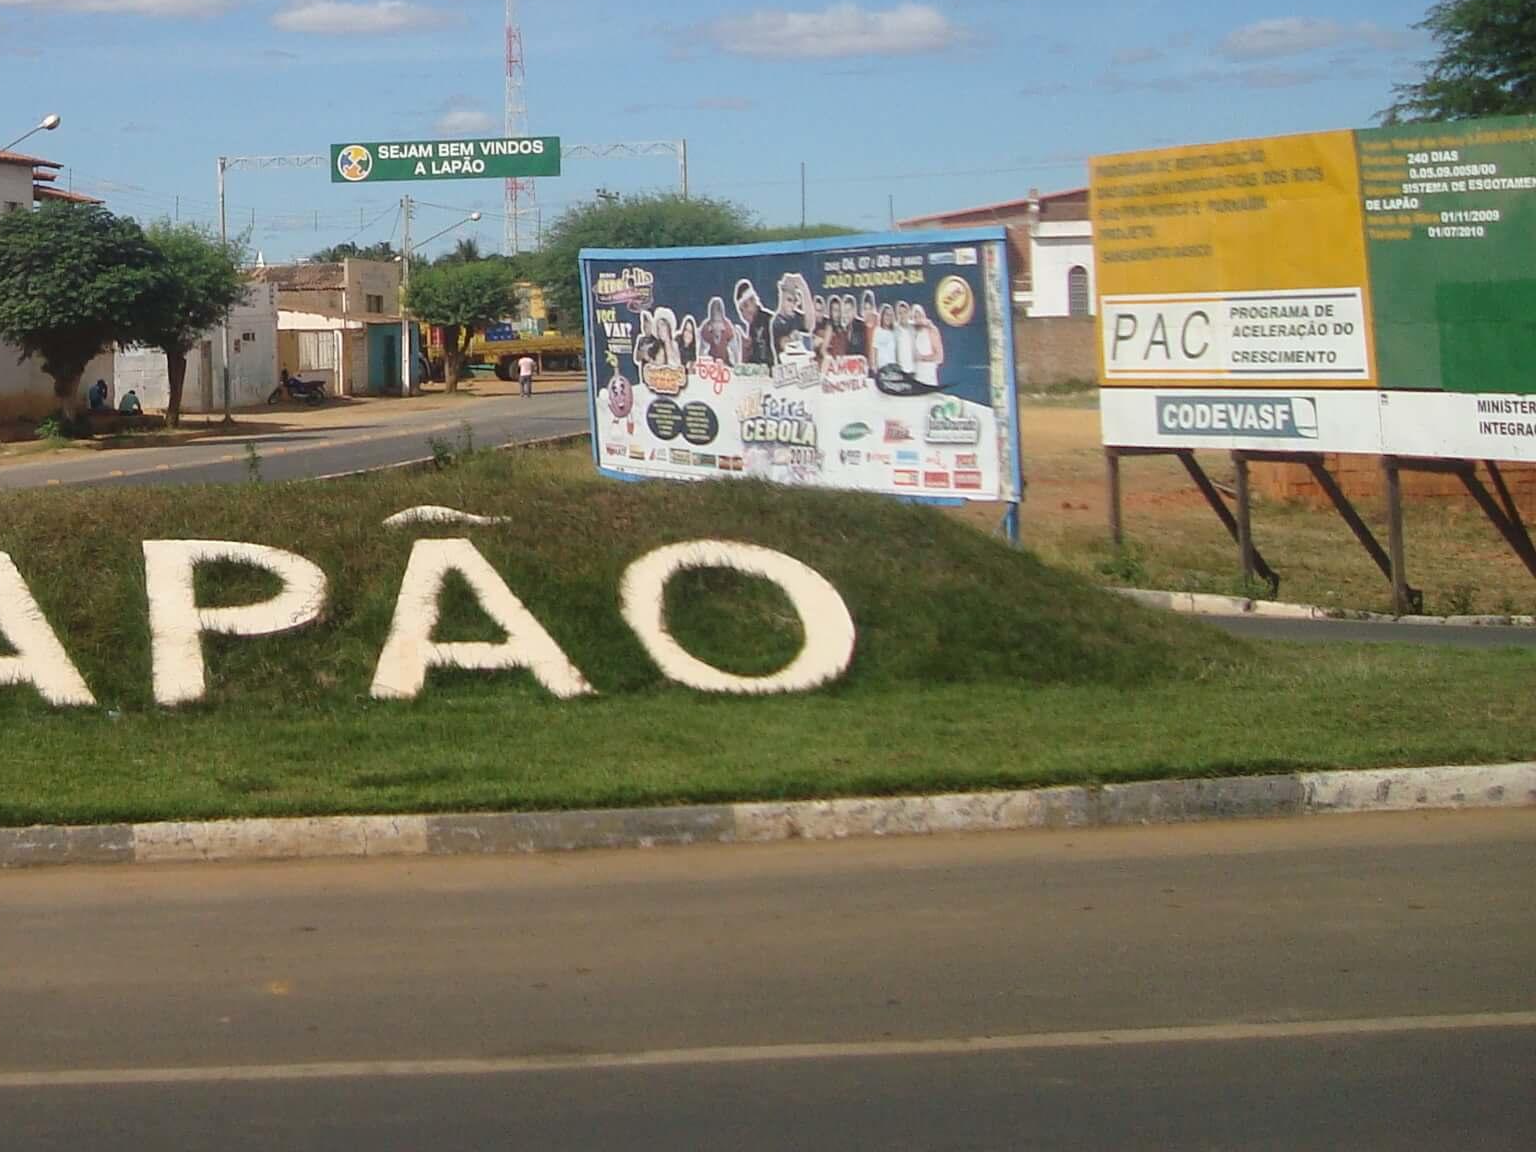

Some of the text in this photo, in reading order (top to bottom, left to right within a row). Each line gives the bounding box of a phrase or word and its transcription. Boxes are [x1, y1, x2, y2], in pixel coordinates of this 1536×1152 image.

[378, 140, 544, 160] SEJAM BEM VINDOS
[1407, 153, 1429, 164] 240
[1431, 151, 1459, 162] DIAS
[414, 157, 485, 175] A LAPÃO
[1402, 182, 1449, 194] SISTEMA
[1452, 181, 1467, 192] DE
[1365, 197, 1419, 211] DE LAPÃO
[1230, 304, 1334, 319] PROGRAMA DE
[1111, 310, 1211, 361] PAC
[1232, 320, 1354, 340] ACELERAÇÃO DO
[1231, 350, 1337, 364] CRESCIMENTO
[1163, 403, 1291, 431] CODEVASF
[742, 418, 816, 446] CEBOLA
